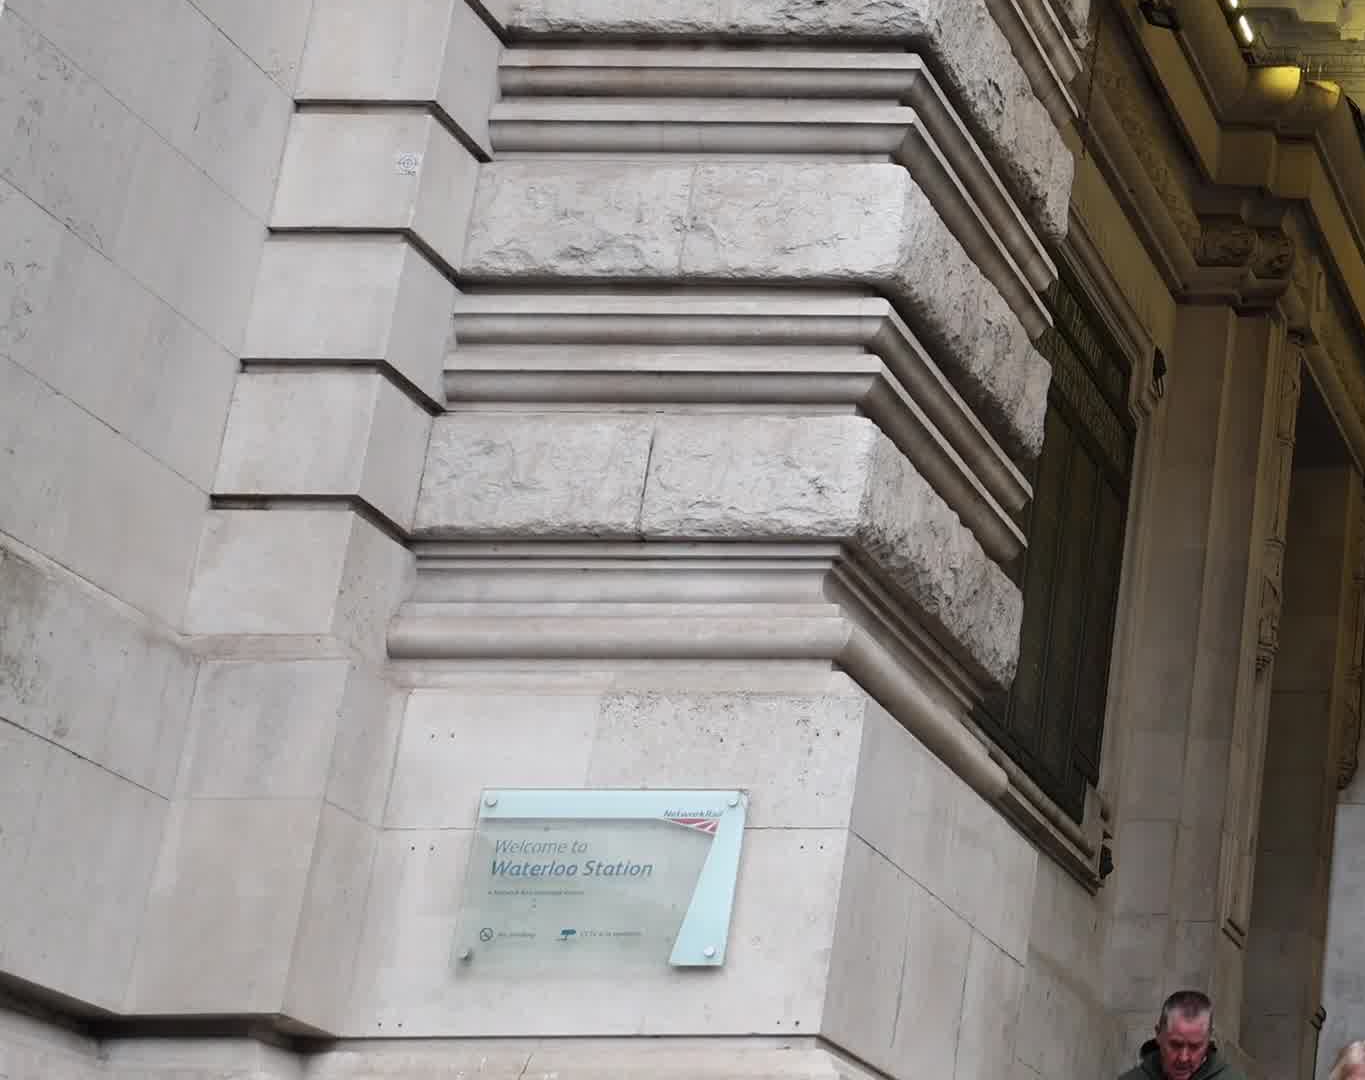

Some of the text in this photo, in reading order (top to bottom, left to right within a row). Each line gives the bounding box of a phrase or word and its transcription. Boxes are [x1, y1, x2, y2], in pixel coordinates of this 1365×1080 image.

[495, 839, 588, 854] Welcome to
[490, 859, 654, 877] Waterloo Station
